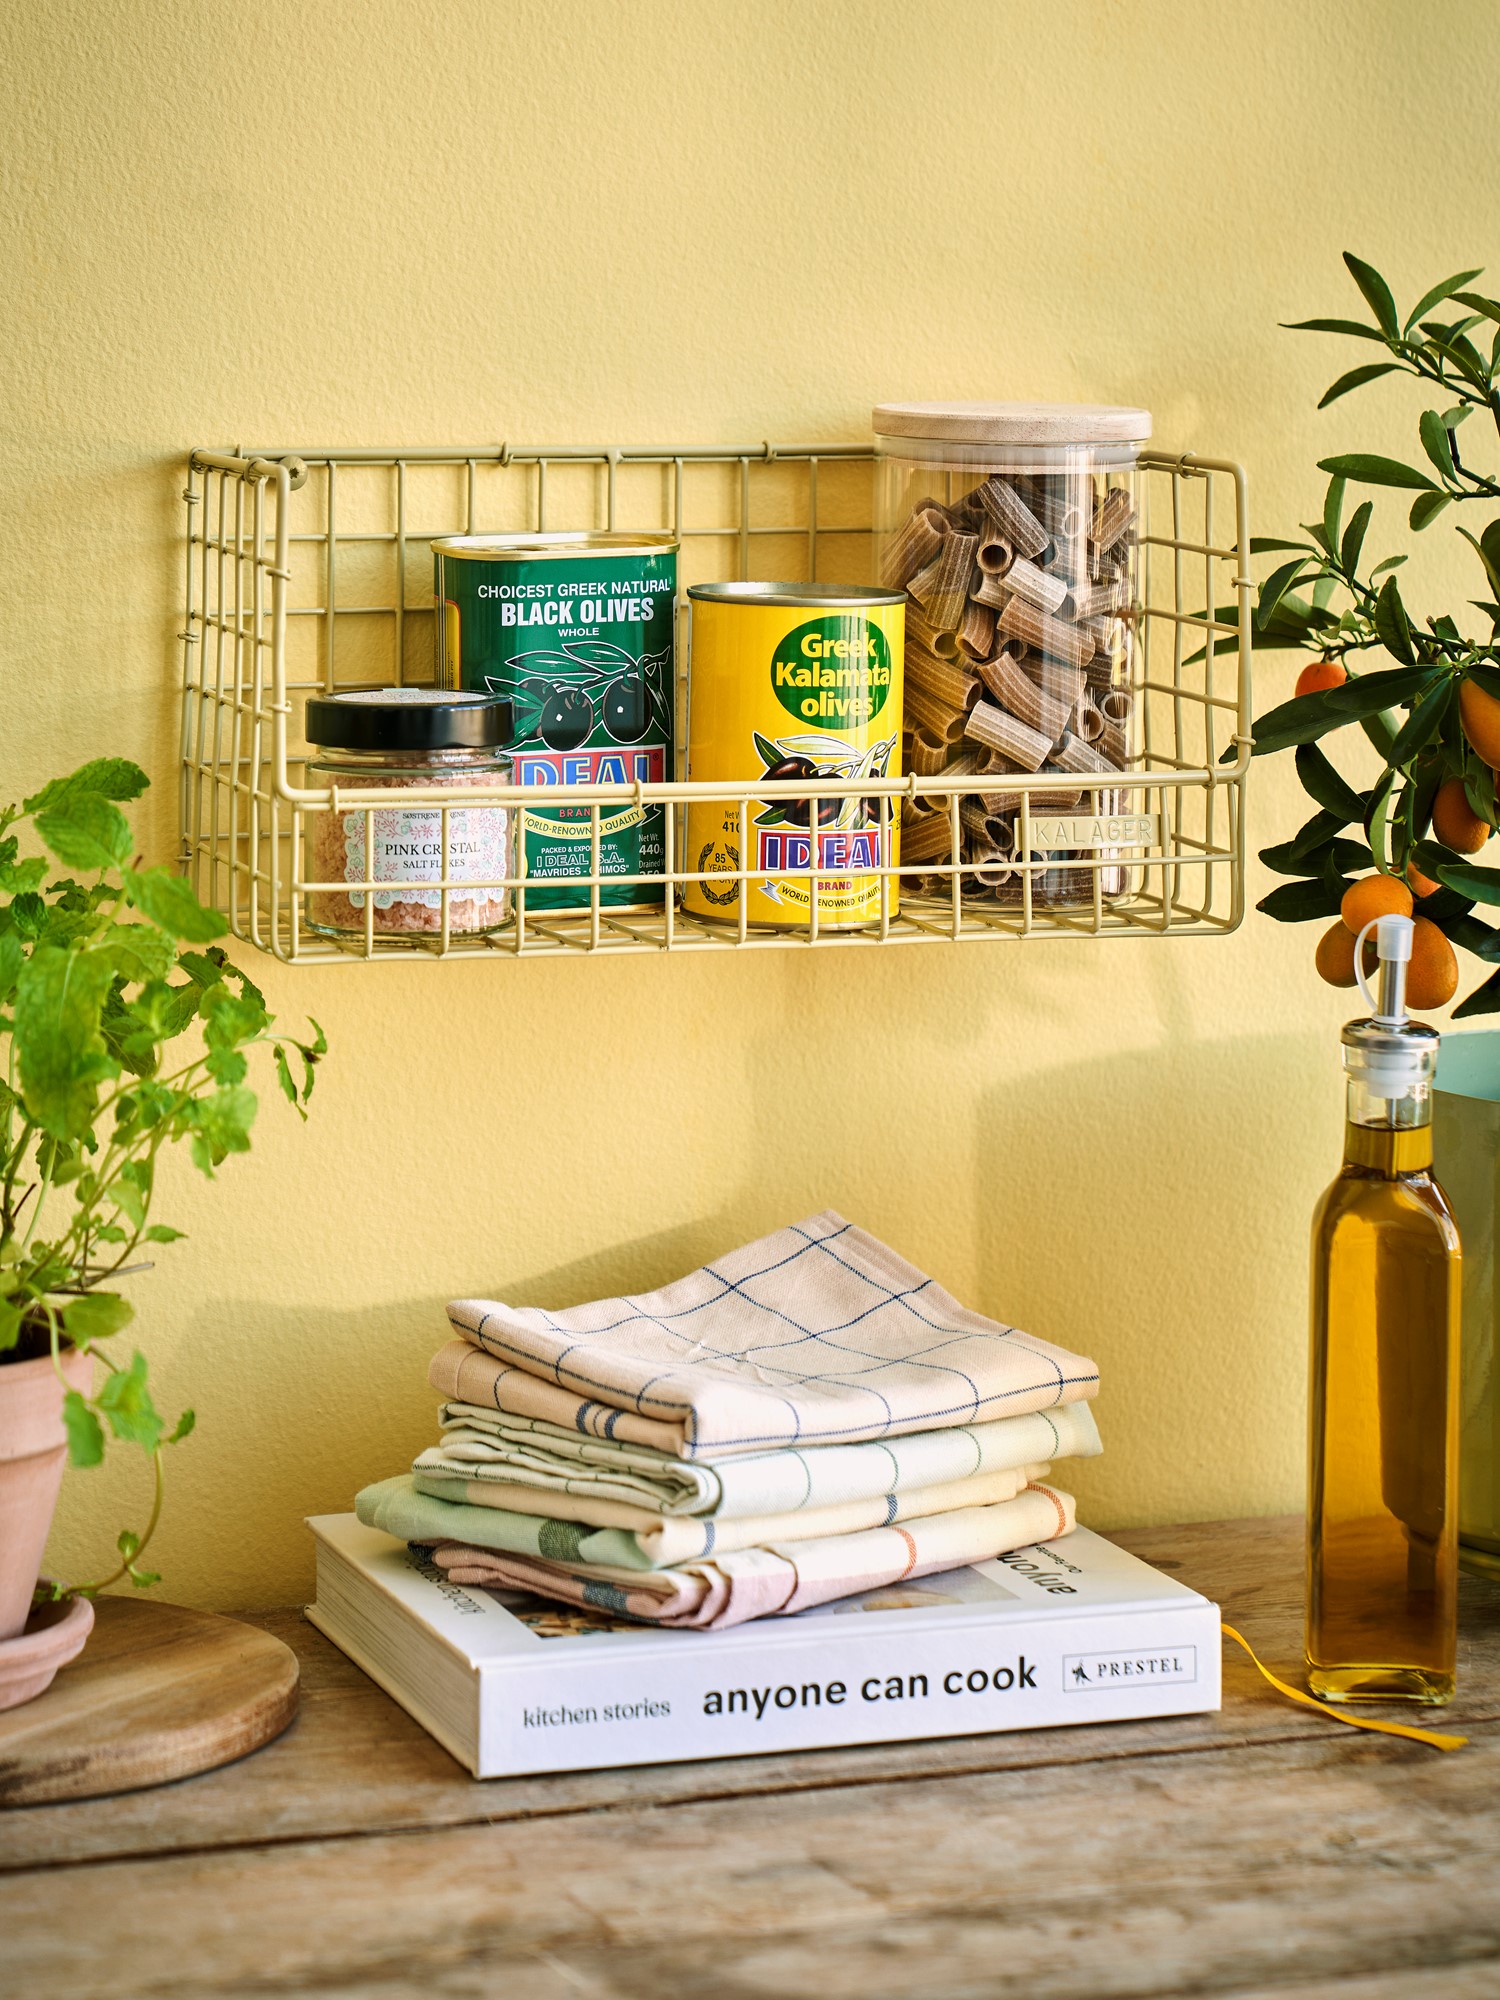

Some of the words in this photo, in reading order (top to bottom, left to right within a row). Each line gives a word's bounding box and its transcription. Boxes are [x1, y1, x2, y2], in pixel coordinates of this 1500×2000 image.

[477, 584, 554, 599] CHOICEST
[557, 582, 607, 596] GREEK
[611, 578, 671, 594] NATURAL
[501, 601, 574, 627] BLACK
[580, 597, 654, 624] OLIVES
[557, 628, 600, 637] WHOLE
[800, 632, 877, 658] Greek
[775, 661, 890, 687] Kalamata
[800, 690, 874, 717] olives
[559, 808, 592, 818] BRAN
[724, 810, 735, 819] Net
[525, 817, 603, 836] ORLD-RENOWND
[605, 810, 641, 831] QUALITY
[1034, 819, 1154, 844] KALAGER
[638, 833, 650, 842] Net
[384, 843, 419, 855] PINK
[422, 842, 481, 855] CRSTAL
[541, 846, 566, 854] PACKED
[574, 844, 607, 853] EXPOED
[638, 858, 661, 868] Drained
[715, 853, 726, 863] 85
[402, 860, 428, 869] SALT
[430, 859, 465, 869] FLKES
[817, 881, 852, 891] BRAND
[817, 897, 856, 907] ENOWNED
[1097, 1656, 1184, 1679] PRESTEL
[523, 1698, 598, 1729] kitchen
[603, 1697, 671, 1722] stories
[703, 1680, 848, 1721] anyone
[860, 1674, 929, 1702] can
[942, 1655, 1038, 1695] cook
